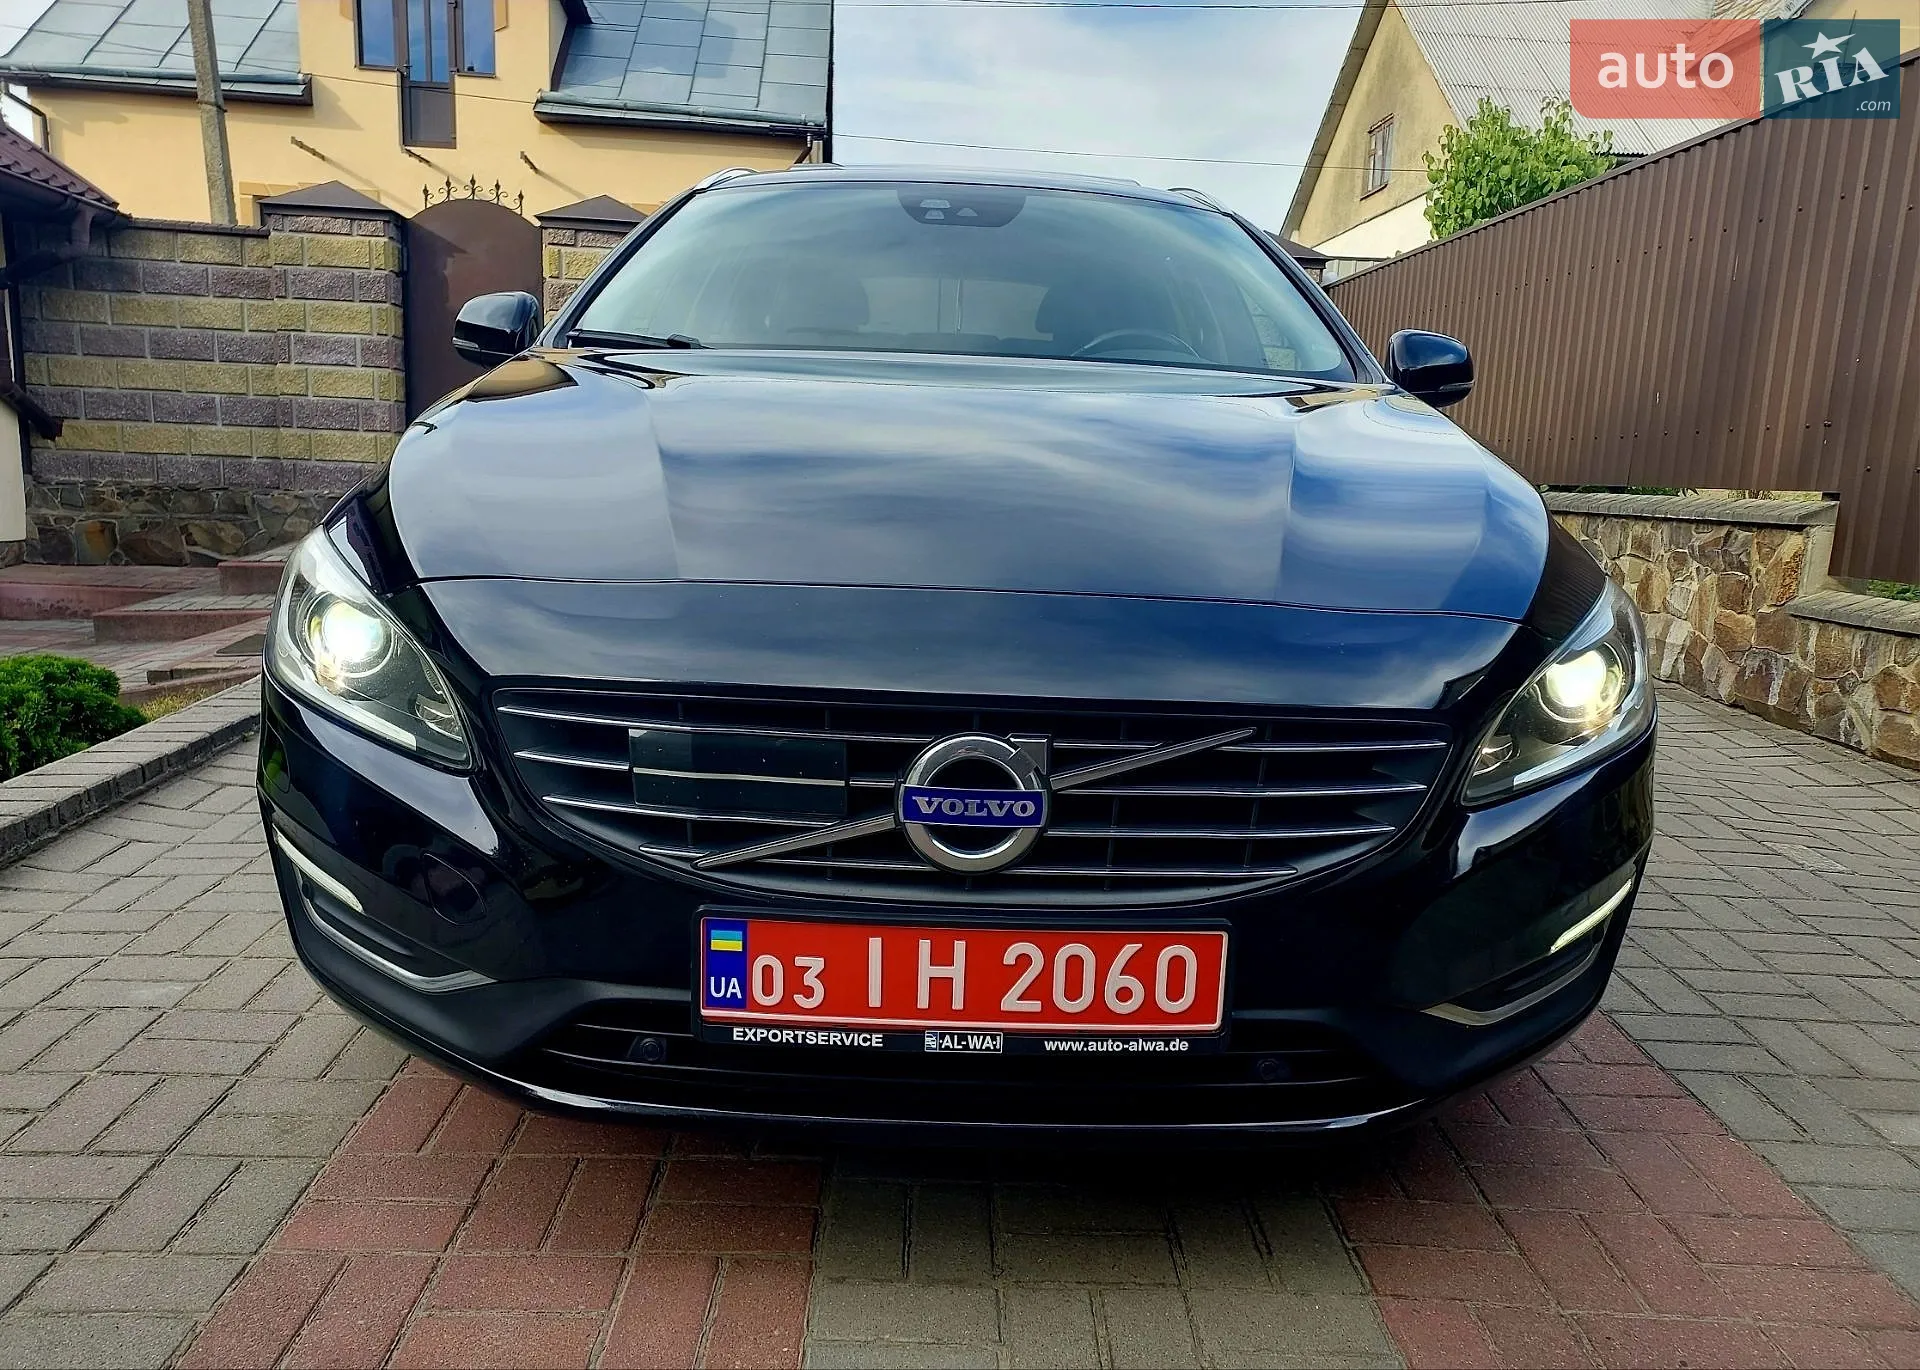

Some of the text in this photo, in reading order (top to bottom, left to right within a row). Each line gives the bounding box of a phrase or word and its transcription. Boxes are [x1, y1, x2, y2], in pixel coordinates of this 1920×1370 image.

[912, 796, 1035, 817] VOLVO
[710, 976, 742, 999] UA
[752, 954, 825, 1009] 03
[1001, 942, 1198, 1014] 2060
[732, 1027, 883, 1047] EXPORTSERVICE
[1044, 1038, 1189, 1052] www.auto-alwa.de
